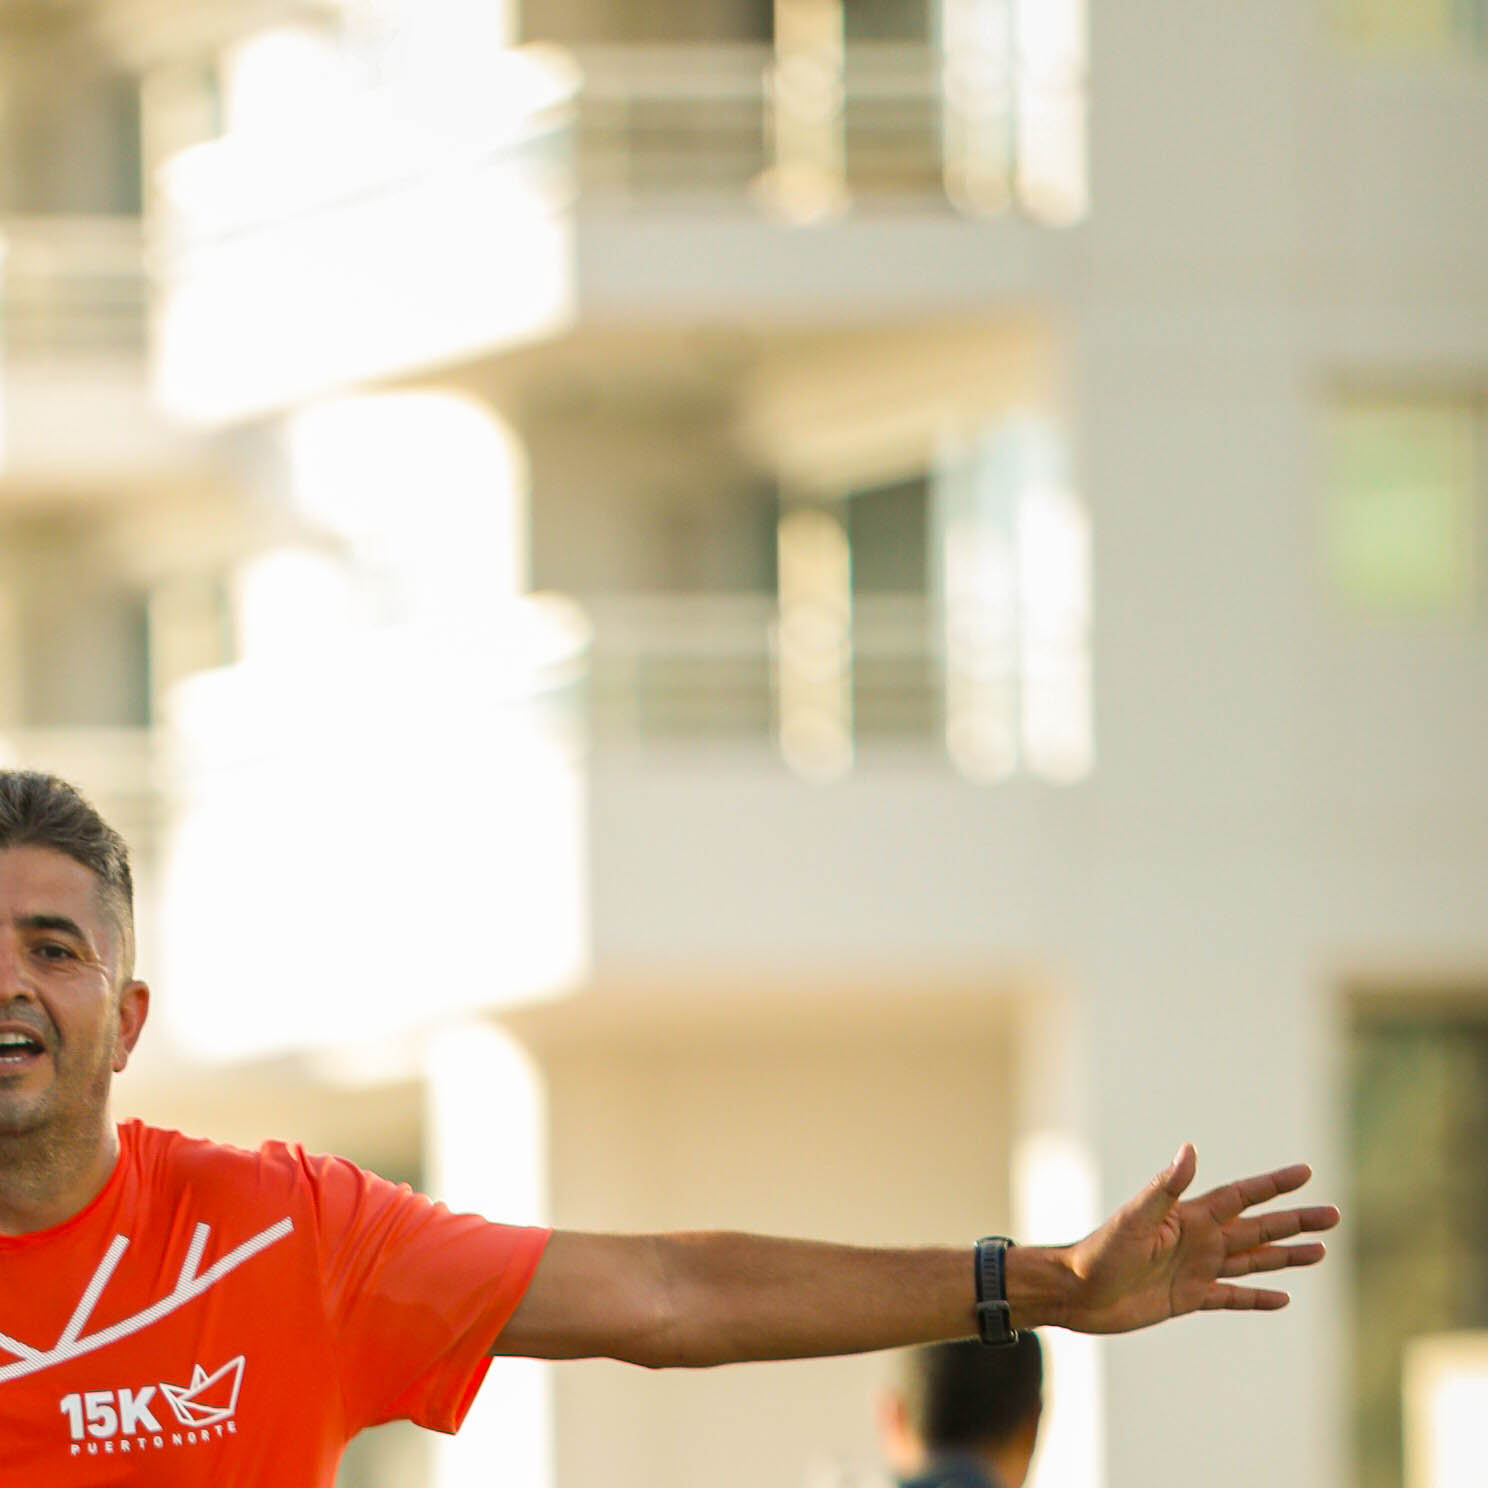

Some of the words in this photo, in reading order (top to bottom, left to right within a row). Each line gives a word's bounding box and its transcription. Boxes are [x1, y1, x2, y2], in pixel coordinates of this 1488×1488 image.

[60, 1386, 163, 1441] 15K
[70, 1435, 164, 1457] PUERTO
[171, 1420, 238, 1447] NORTE
